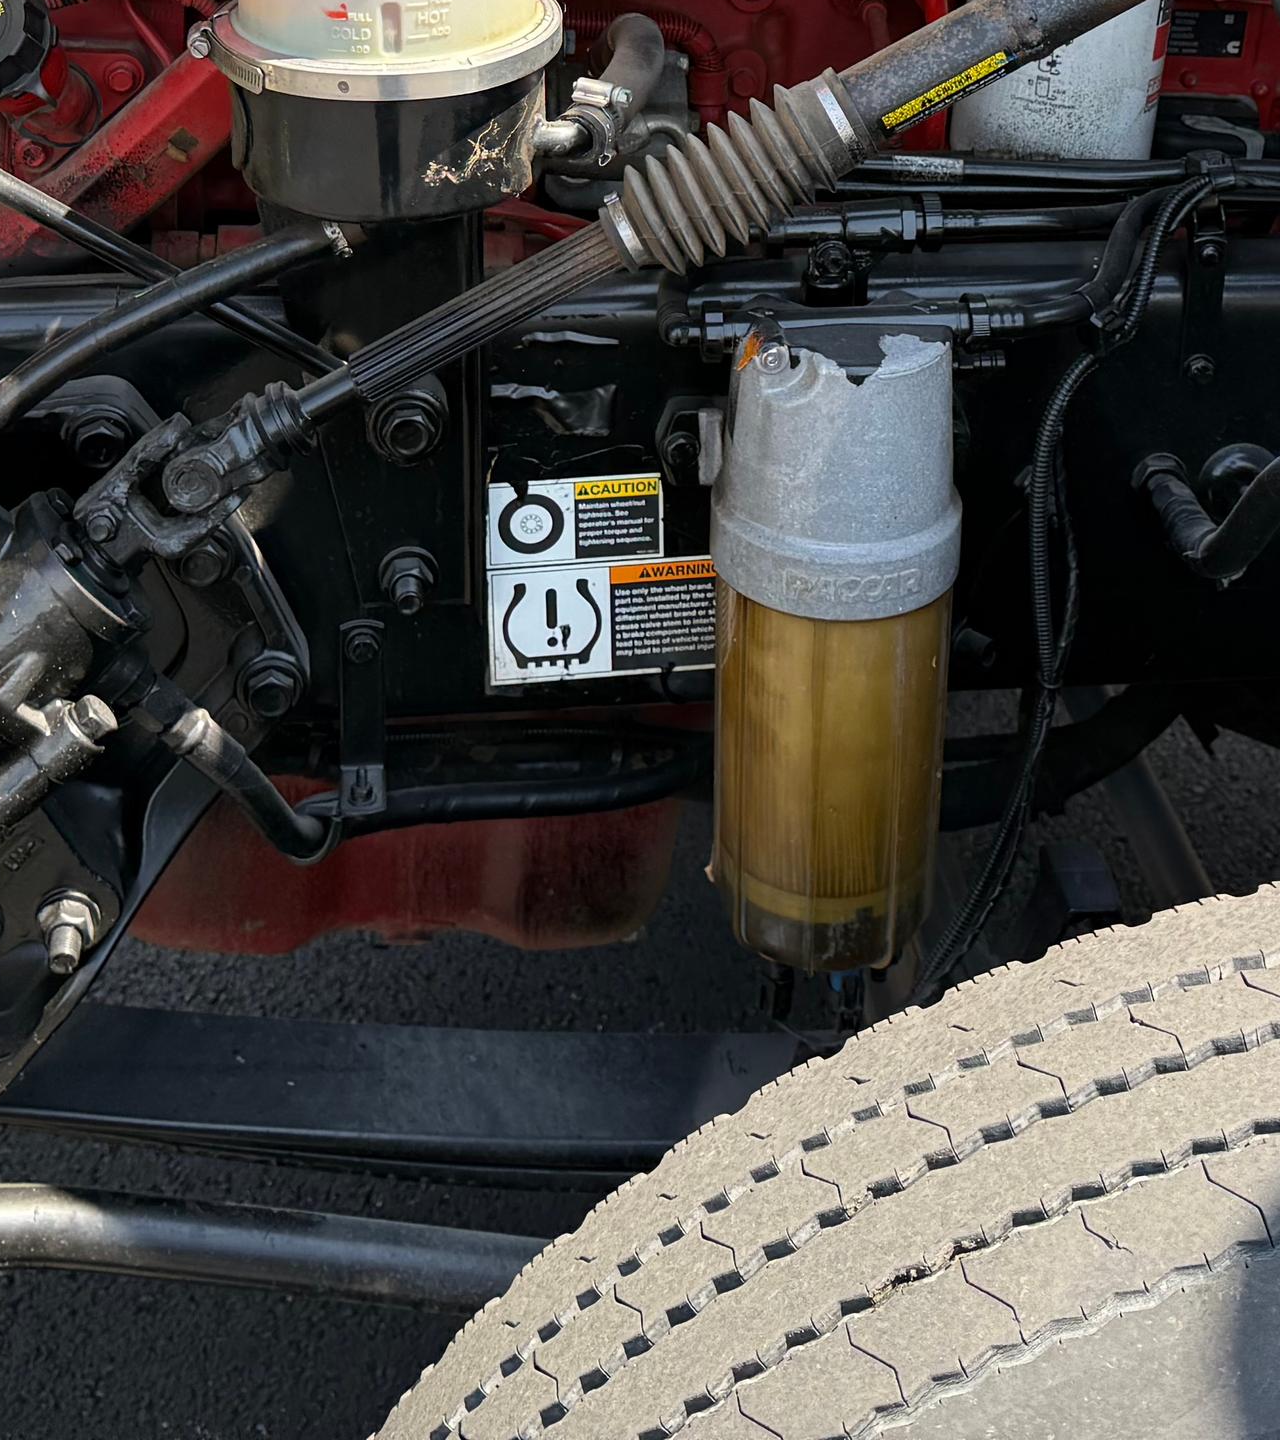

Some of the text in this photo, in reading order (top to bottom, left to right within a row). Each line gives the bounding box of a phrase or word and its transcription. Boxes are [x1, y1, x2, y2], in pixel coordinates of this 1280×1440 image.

[348, 12, 372, 22] FULL
[418, 8, 448, 24] HOT
[331, 27, 371, 41] COLD
[590, 482, 656, 495] CAUTION
[615, 598, 631, 606] part
[647, 594, 679, 602] installed
[615, 601, 712, 613] equipment manufacturer.
[616, 614, 648, 622] different
[646, 629, 689, 637] component
[662, 643, 695, 653] personal
